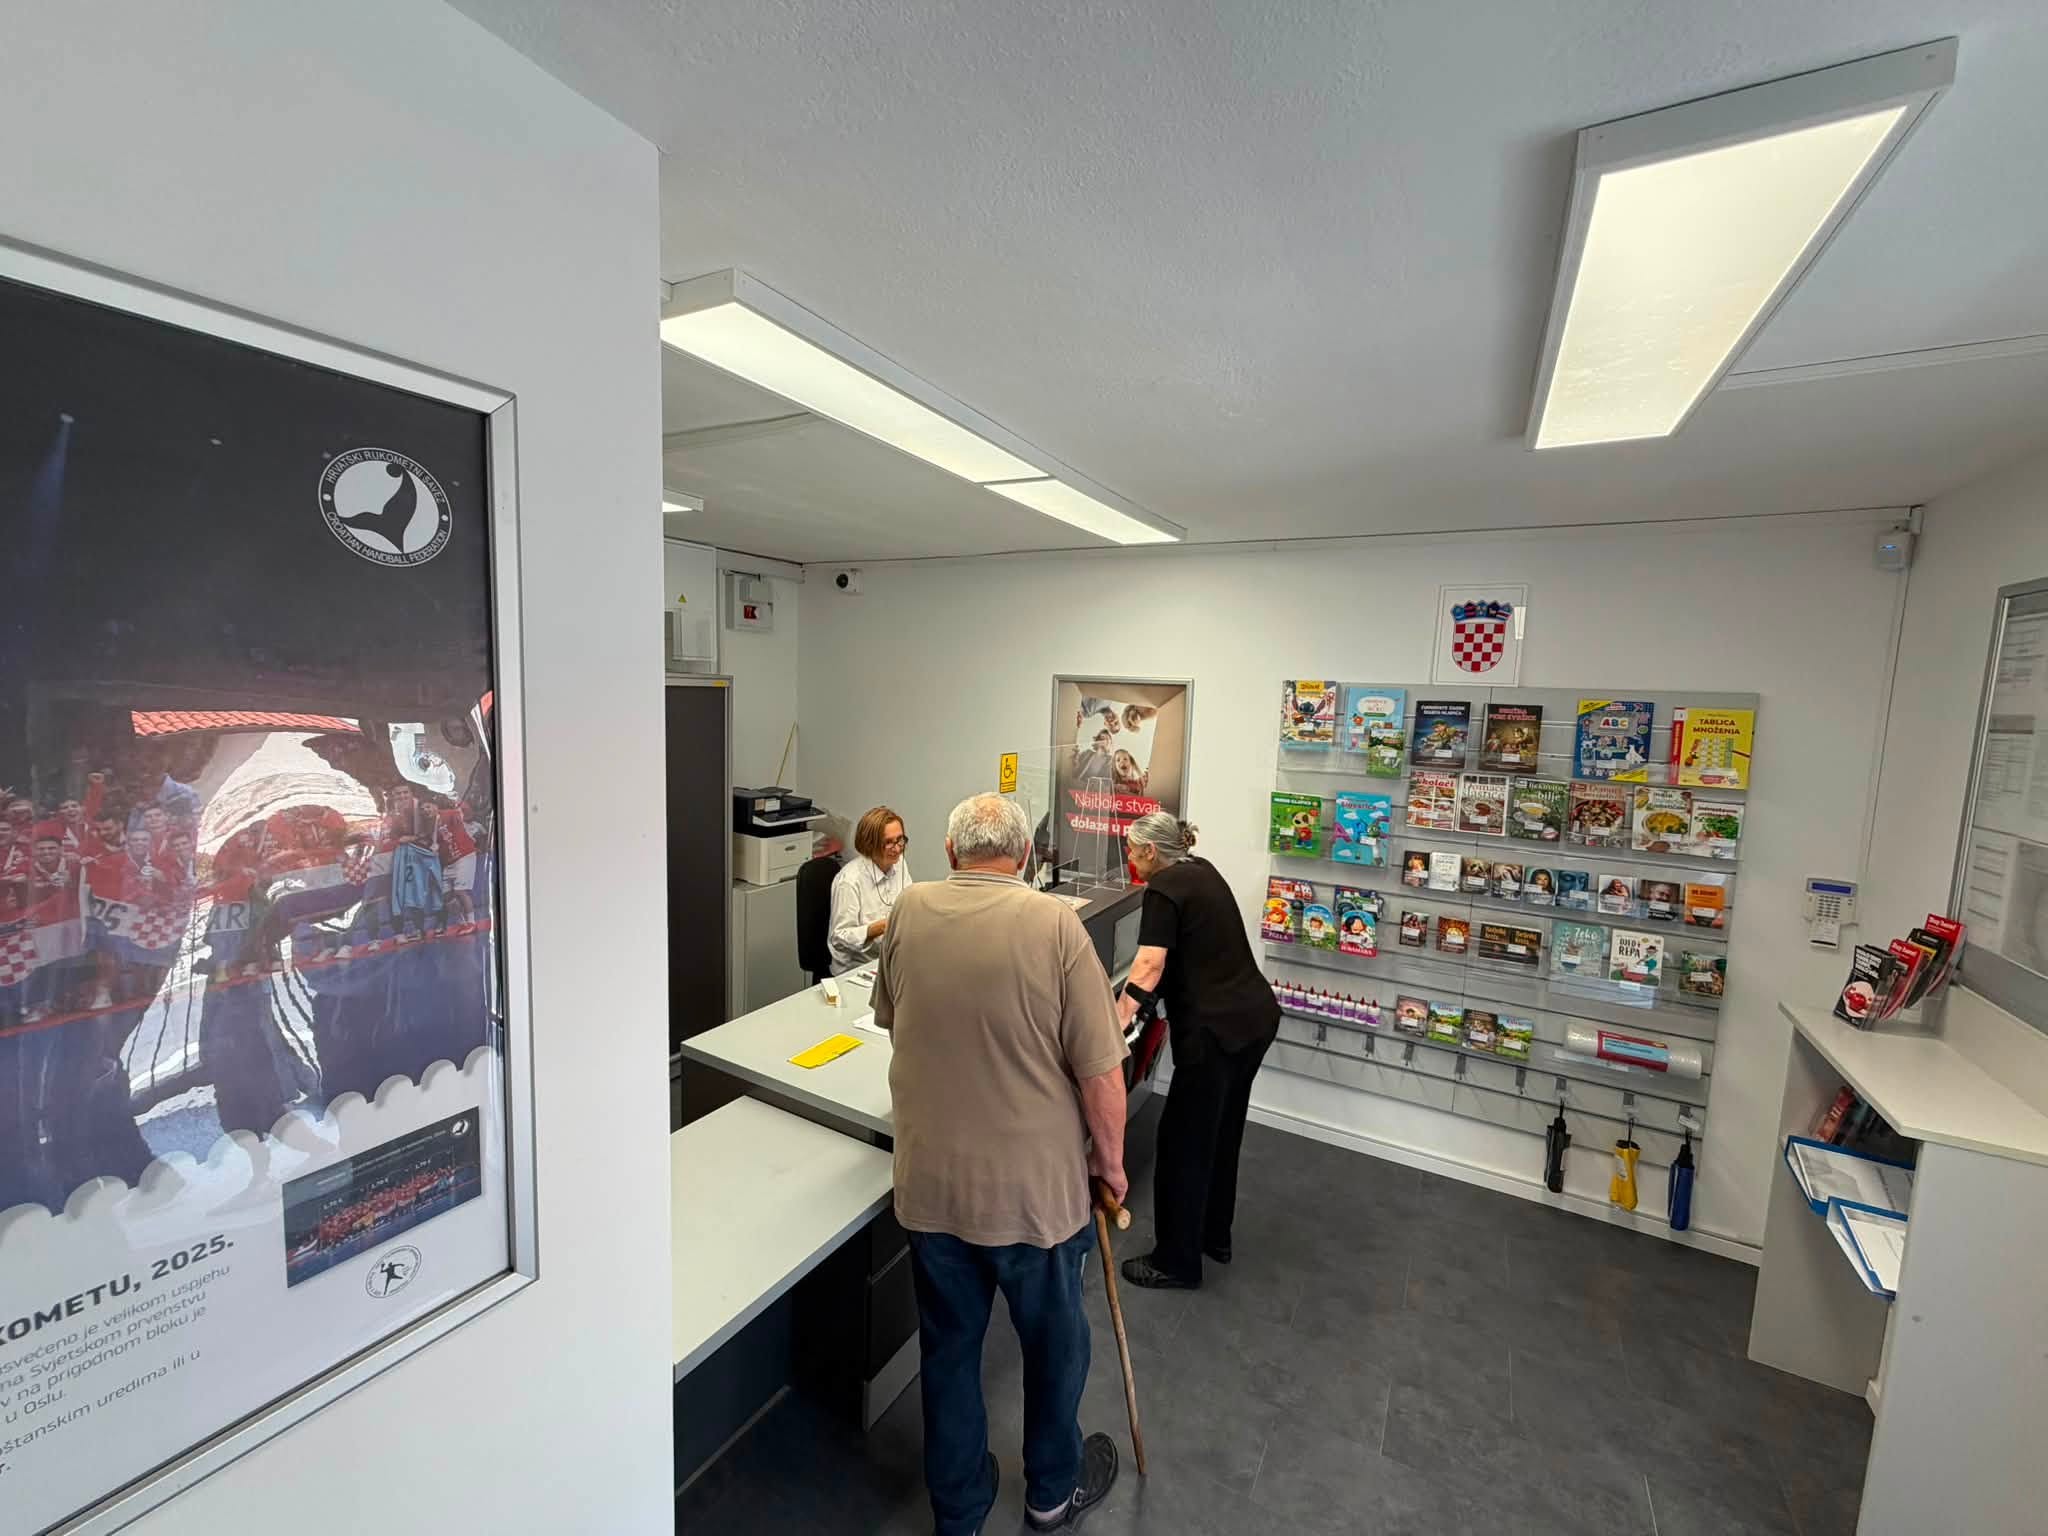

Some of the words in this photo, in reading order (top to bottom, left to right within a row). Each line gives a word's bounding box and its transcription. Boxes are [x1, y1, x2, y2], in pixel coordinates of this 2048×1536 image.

[1699, 718, 1736, 726] TABLICA
[1070, 816, 1110, 832] dolaze
[1111, 824, 1120, 833] u
[1074, 793, 1123, 812] Najbolje
[1126, 799, 1161, 813] stvari
[151, 1234, 235, 1281] 2025.
[83, 1323, 98, 1340] je
[103, 1293, 166, 1328] velikom
[171, 1265, 230, 1298] uspjehu
[17, 1383, 41, 1401] na
[48, 1336, 141, 1390] prigodnom
[146, 1315, 189, 1342] bloku
[191, 1306, 206, 1322] je
[30, 1330, 121, 1379] Svjetskom
[127, 1291, 206, 1336] prvenstvu
[97, 1366, 168, 1408] uredima
[173, 1354, 185, 1370] ili
[5, 1411, 17, 1424] u
